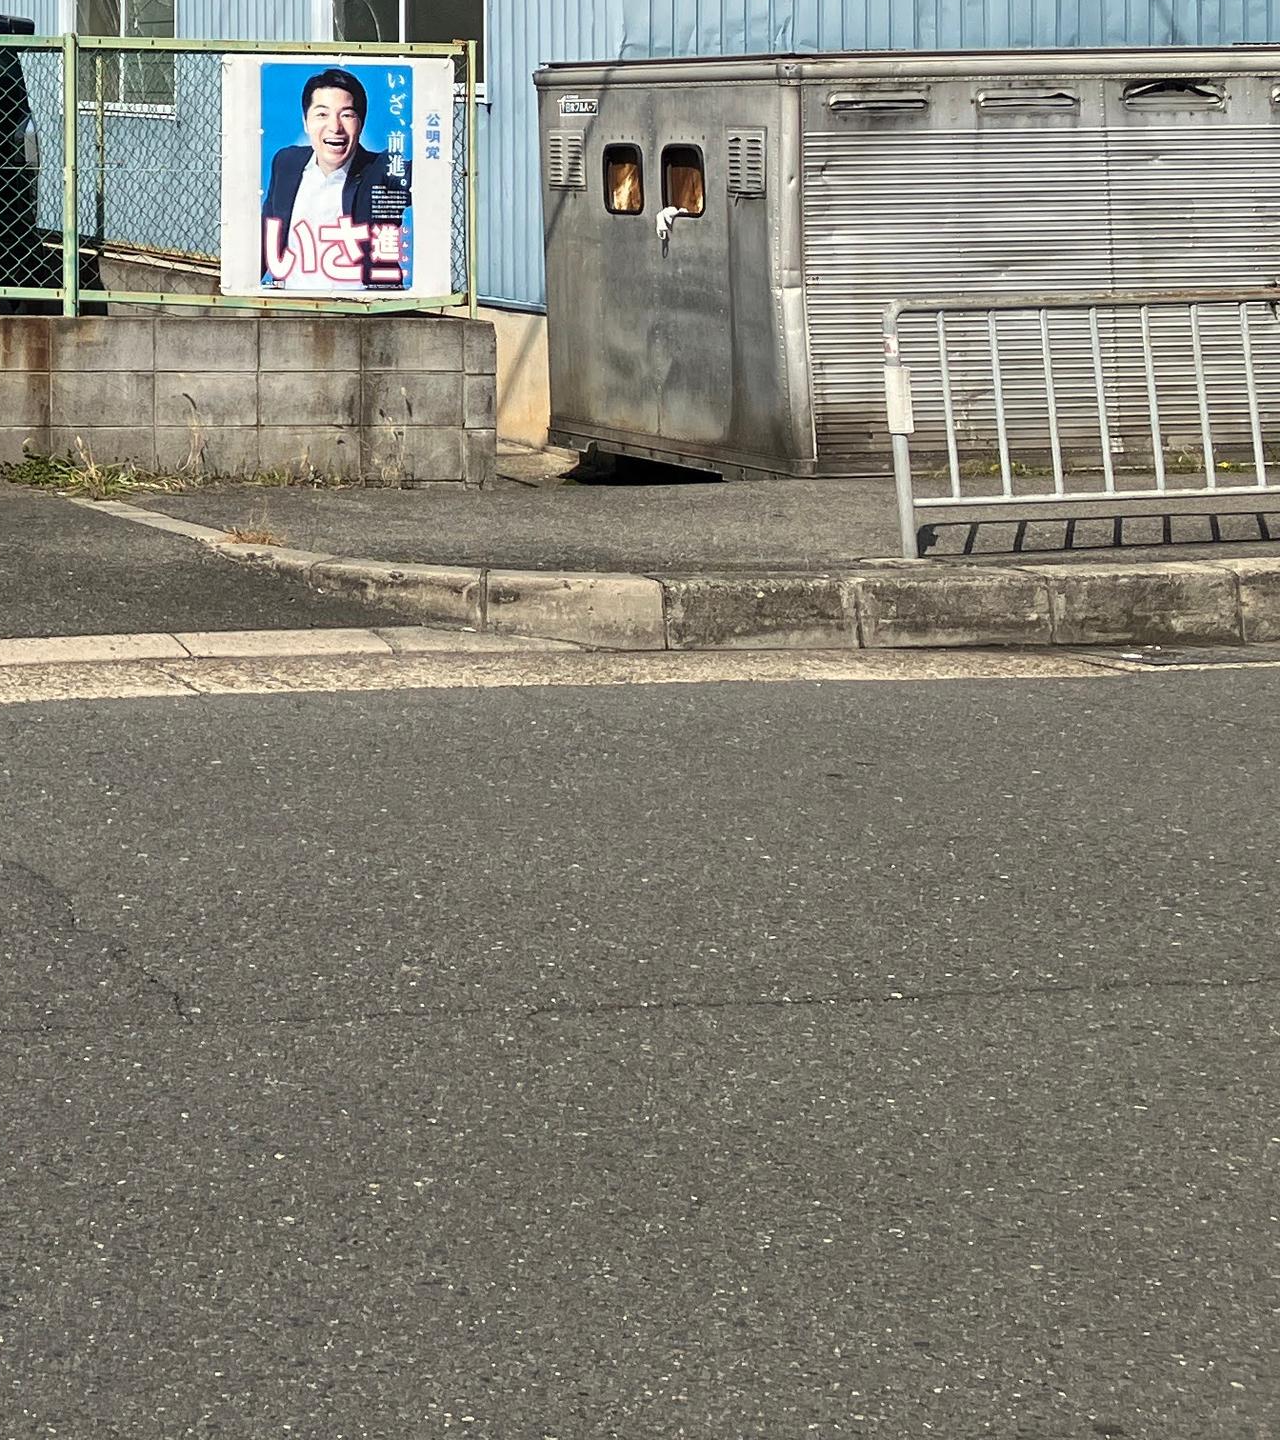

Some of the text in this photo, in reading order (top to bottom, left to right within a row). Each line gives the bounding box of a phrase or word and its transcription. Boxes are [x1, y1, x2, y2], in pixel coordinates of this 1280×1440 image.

[387, 72, 408, 187] いざ、前進。
[425, 113, 441, 160] 公明党
[265, 216, 369, 282] いさ
